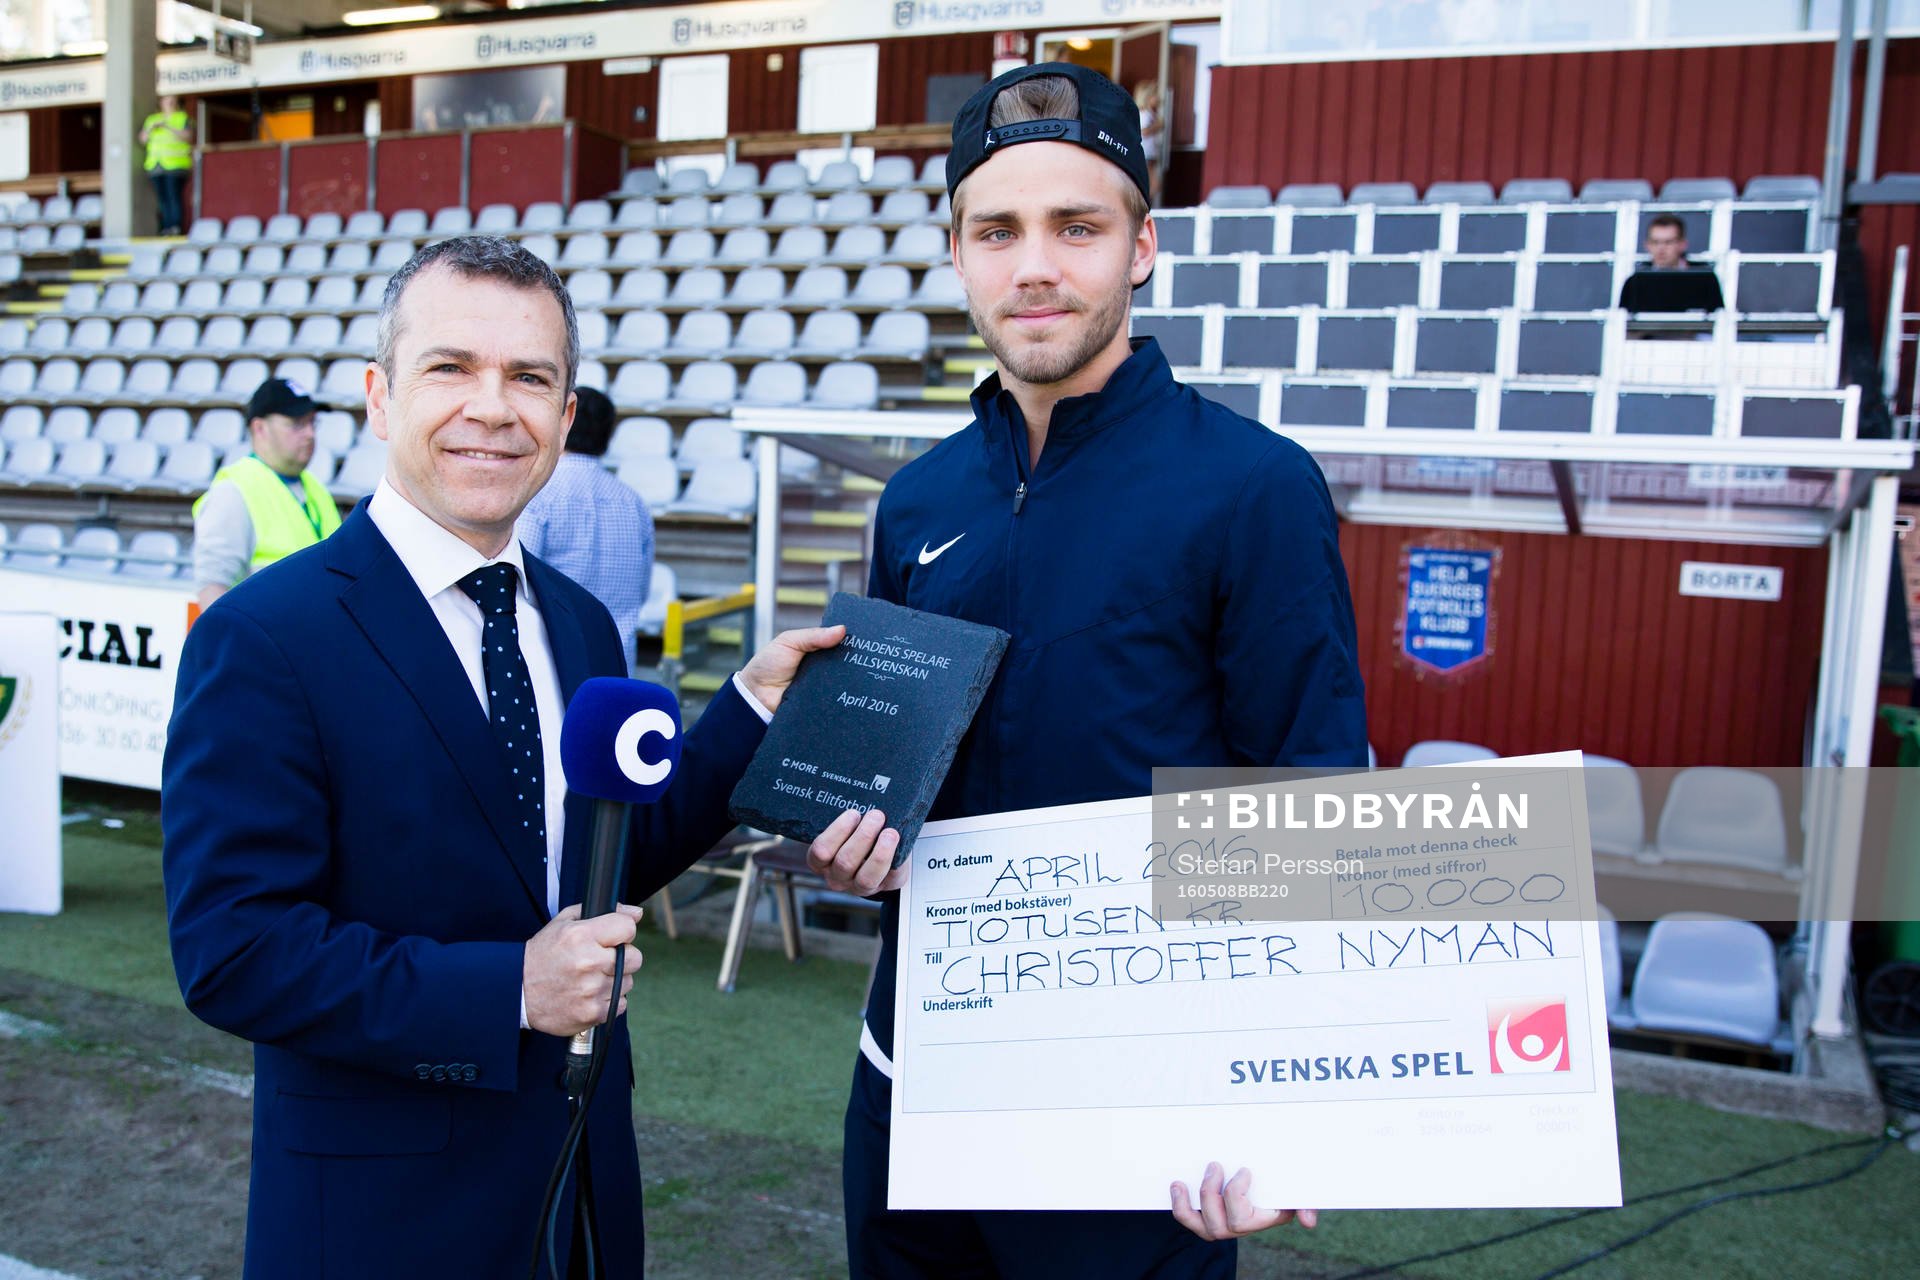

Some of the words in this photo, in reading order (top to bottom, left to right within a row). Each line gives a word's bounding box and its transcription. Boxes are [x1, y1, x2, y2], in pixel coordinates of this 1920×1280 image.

[696, 15, 807, 39] Husqvarna
[498, 32, 596, 55] Husqvarna
[319, 50, 407, 72] Husqvarna
[1098, 130, 1128, 155] DRI-FIT
[1692, 570, 1770, 592] BORTA
[844, 652, 850, 662] I
[849, 654, 929, 680] ALLSVENSKAN
[901, 649, 951, 670] SPELARE
[837, 691, 868, 708] April
[867, 699, 899, 716] 2016
[615, 708, 676, 785] C
[782, 758, 790, 767] C
[790, 760, 819, 775] MORE
[773, 778, 815, 800] Svensk
[821, 771, 851, 785] SVENSKA
[852, 779, 870, 790] SPEL
[1336, 845, 1383, 861] Betala
[1386, 843, 1417, 857] mot
[1420, 840, 1469, 854] denna
[1473, 833, 1518, 849] check
[927, 858, 950, 870] Ort,
[953, 853, 993, 868] datum
[986, 852, 1122, 898] APRIL
[1142, 835, 1259, 879] 2016
[1337, 867, 1388, 882] Kronor
[1393, 864, 1432, 879] (med
[1435, 858, 1487, 875] siffror)
[926, 904, 967, 918] Kronor
[971, 901, 1002, 916] (med
[1005, 894, 1072, 911] bokstäver)
[1342, 873, 1565, 916] 10.000
[932, 904, 1165, 948] TIOTUSEN
[1186, 900, 1254, 927] KR.
[925, 951, 942, 964] Till
[941, 935, 1302, 995] CHRISTOFFER
[1337, 918, 1555, 970] NYMAN
[923, 996, 993, 1012] Underskrift
[1230, 1055, 1380, 1085] SVENSKA
[1391, 1051, 1474, 1079] SPEL
